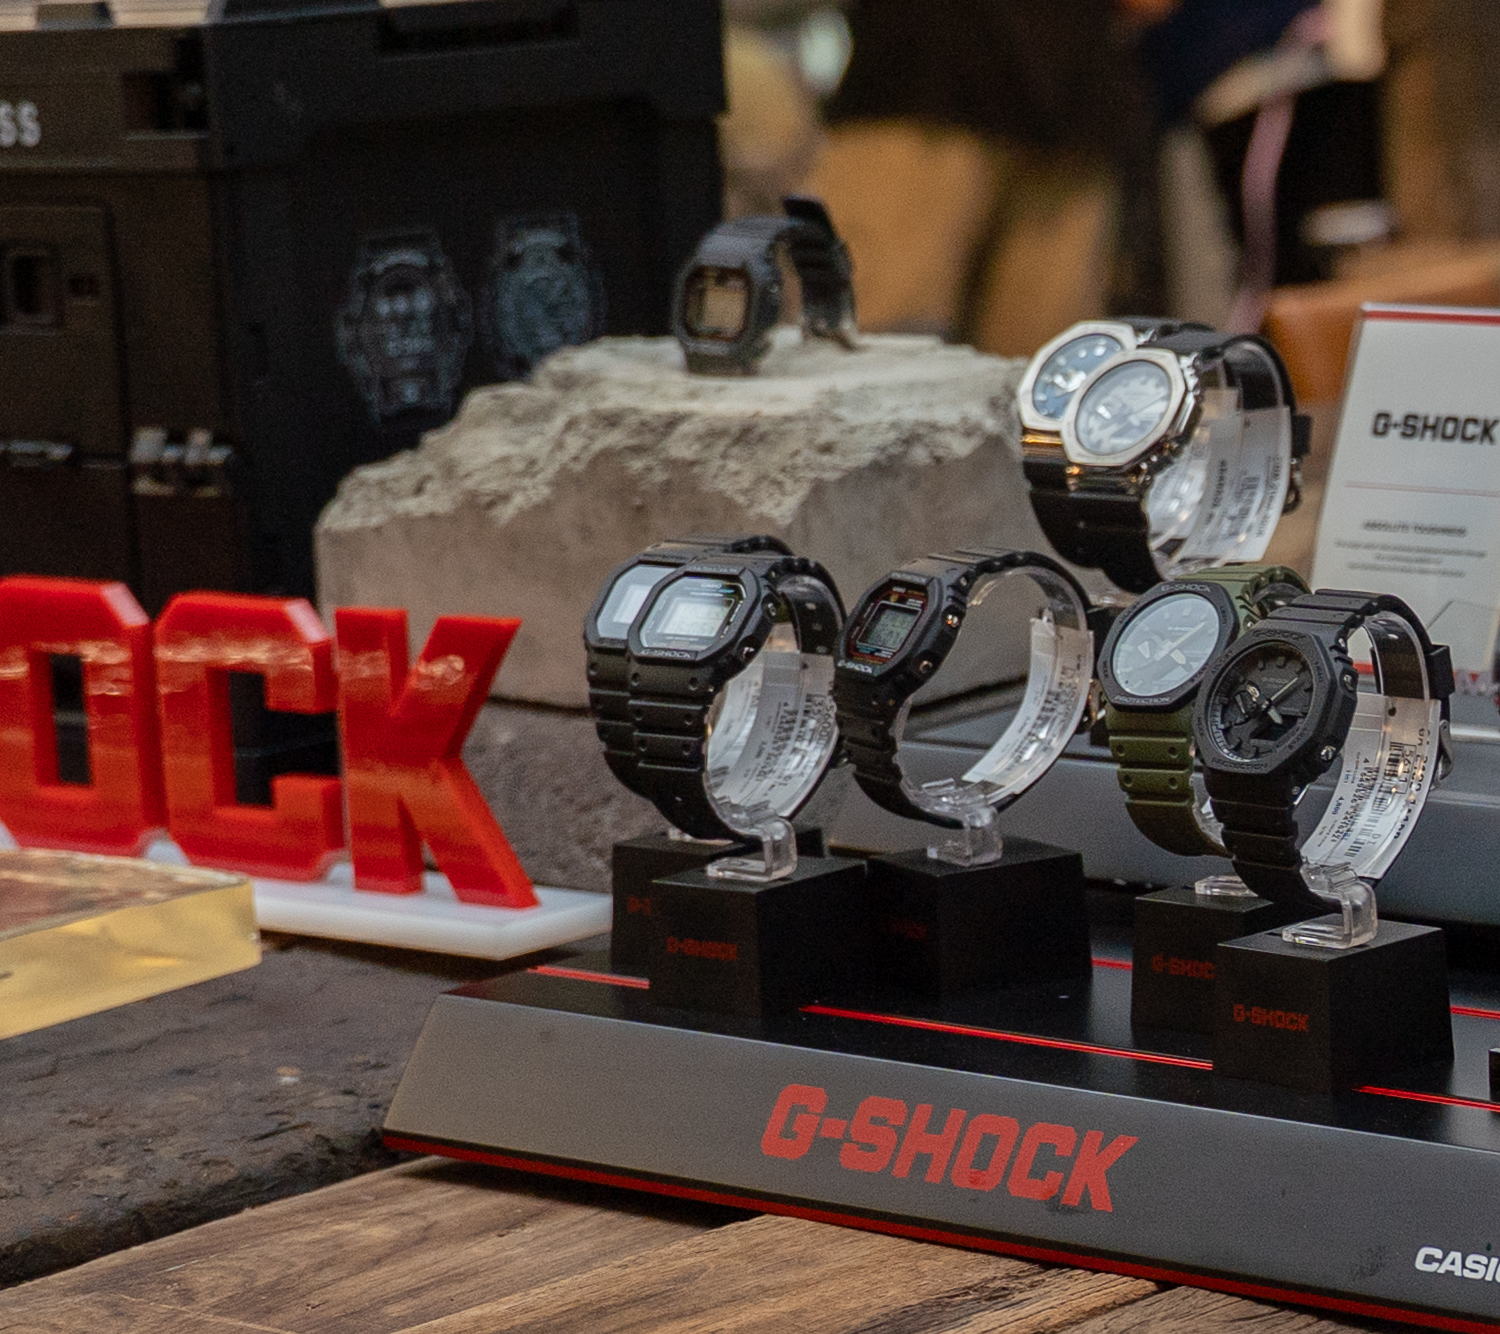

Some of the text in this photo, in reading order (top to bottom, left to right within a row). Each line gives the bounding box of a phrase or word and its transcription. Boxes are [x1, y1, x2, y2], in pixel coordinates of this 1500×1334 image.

[1372, 411, 1500, 447] G-SHOCK
[1160, 582, 1211, 593] G-SHOCK
[638, 650, 692, 660] G-SHOCK
[1114, 694, 1171, 704] PROTECTION
[1151, 953, 1214, 981] G-SHOC
[760, 1083, 1139, 1213] G-SHOCK
